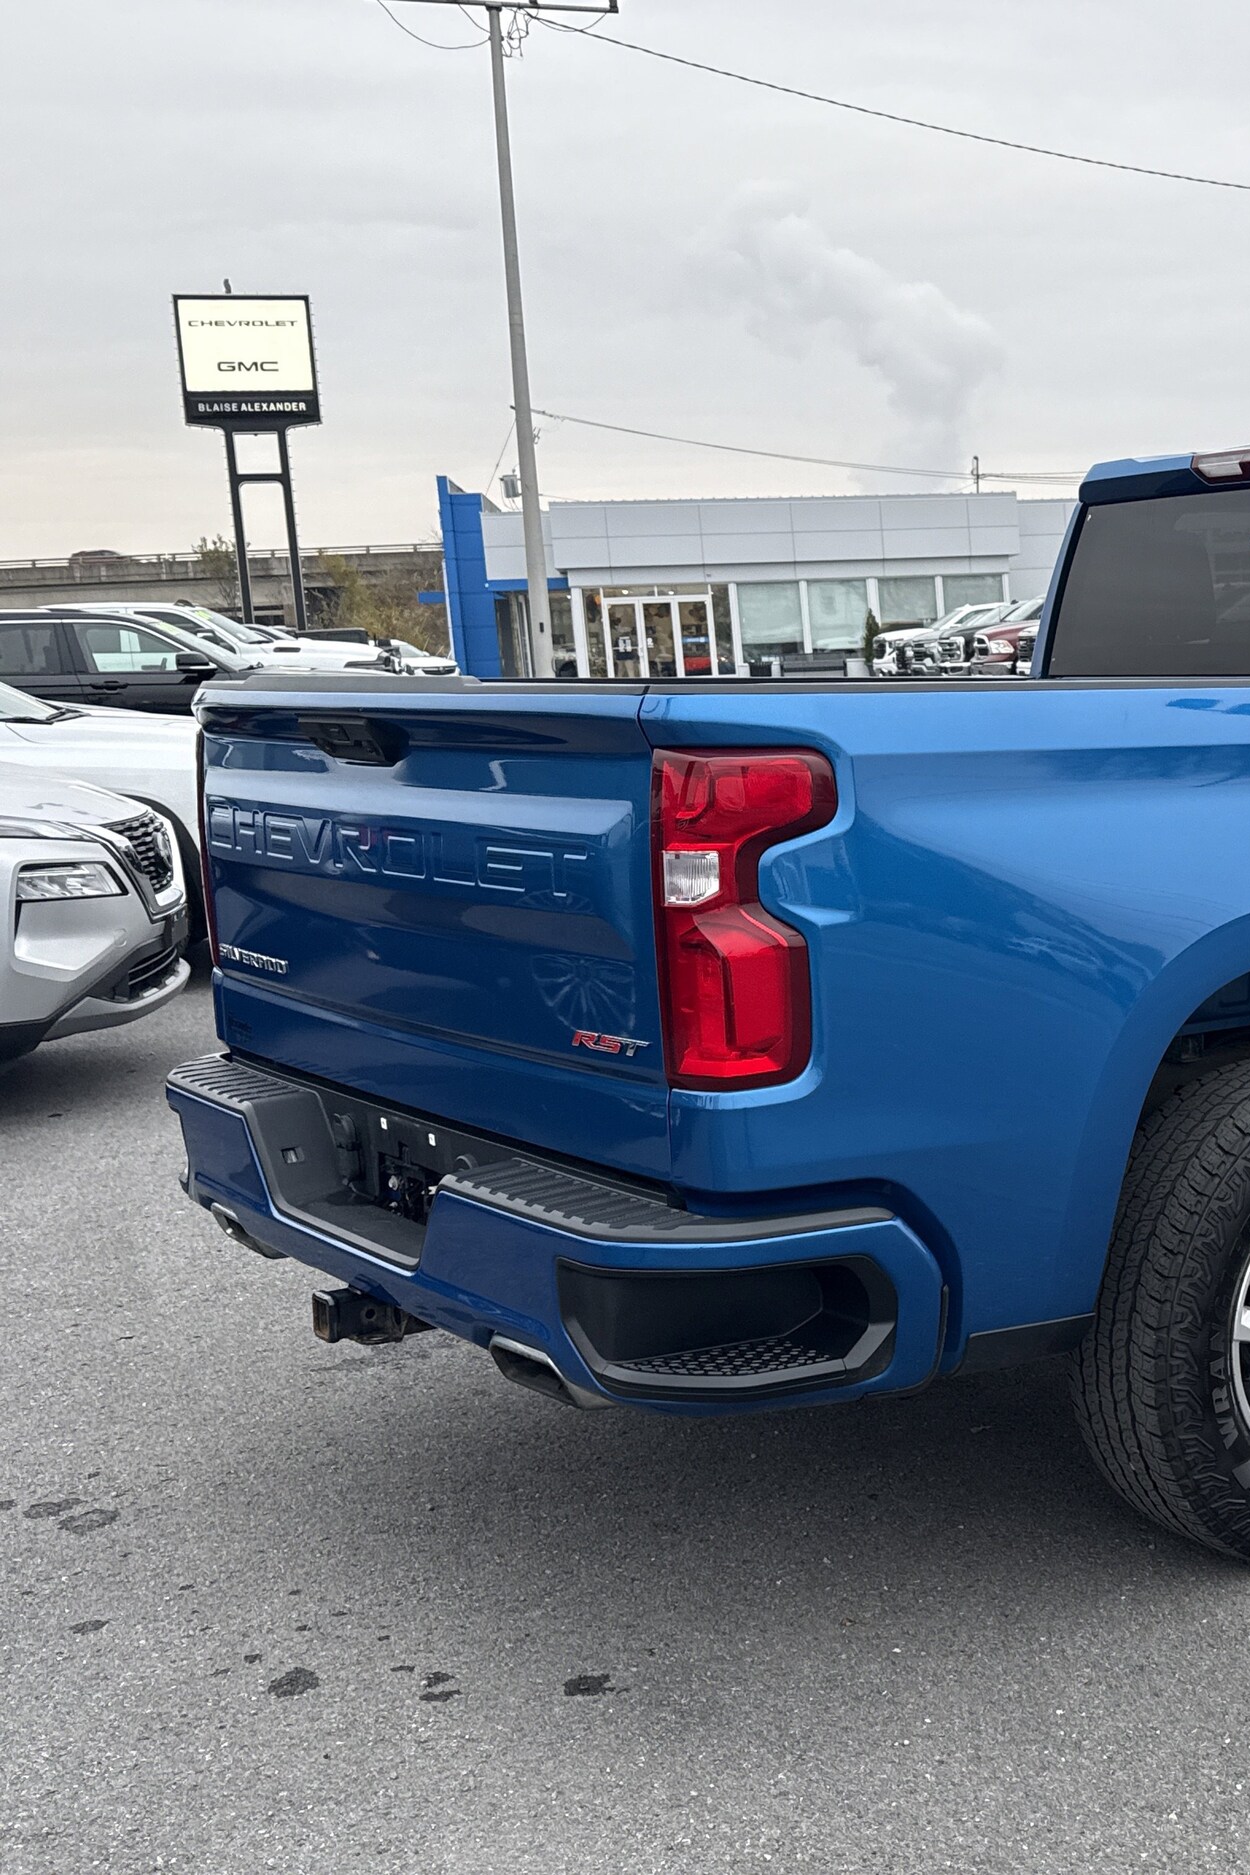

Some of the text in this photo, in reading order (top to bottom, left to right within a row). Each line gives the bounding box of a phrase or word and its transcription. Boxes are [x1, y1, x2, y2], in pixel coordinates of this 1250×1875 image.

[217, 361, 279, 372] GMC
[198, 402, 307, 412] BLAISE ALEXANDER
[210, 805, 588, 897] CHEVROLET
[218, 943, 289, 974] SILVERADO
[571, 1029, 653, 1056] RST
